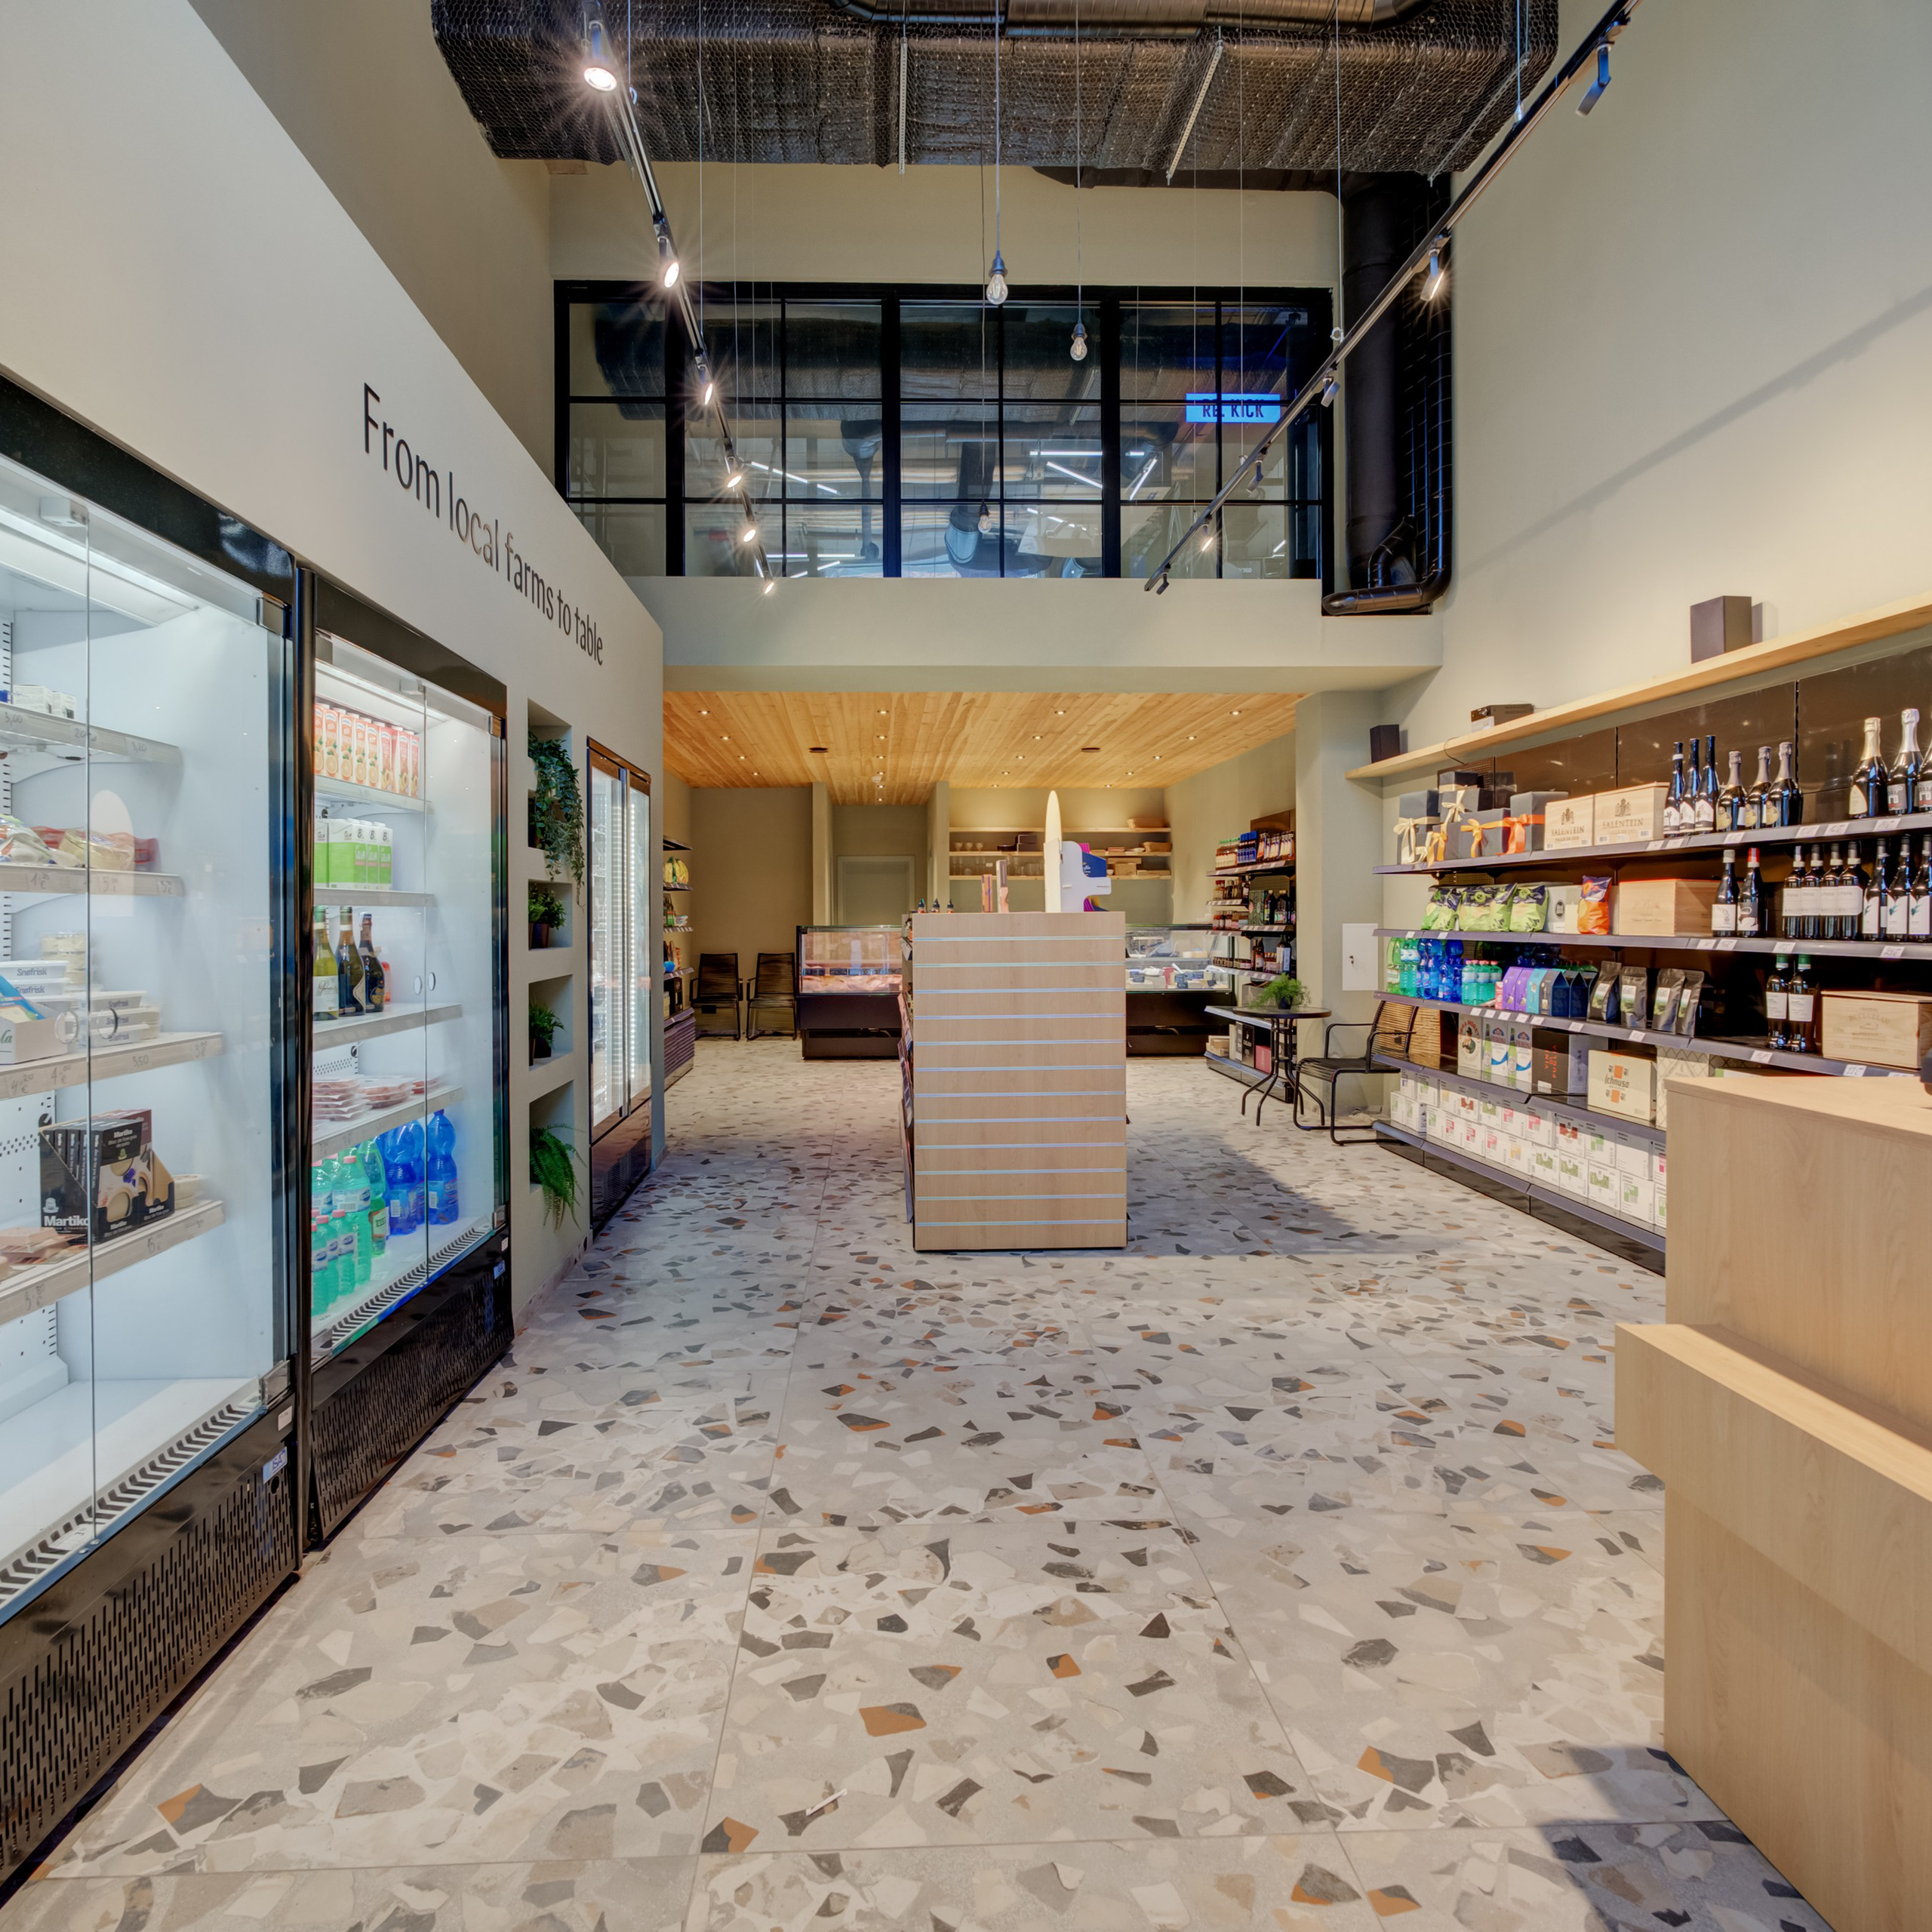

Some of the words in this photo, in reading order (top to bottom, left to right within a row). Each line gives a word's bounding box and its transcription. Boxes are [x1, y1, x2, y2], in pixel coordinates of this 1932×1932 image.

[1231, 399, 1264, 417] KICK
[364, 383, 440, 518] From
[449, 471, 499, 572] local
[505, 532, 553, 620] farms
[557, 589, 571, 635] to
[574, 607, 603, 666] table
[1602, 819, 1644, 829] SALENTEIN
[1551, 826, 1584, 836] SALENTEIN
[17, 968, 48, 977] Snøfrisk
[106, 1017, 129, 1025] Snfrisk
[1604, 1074, 1629, 1088] Ichnusa
[44, 1214, 88, 1227] Martiko
